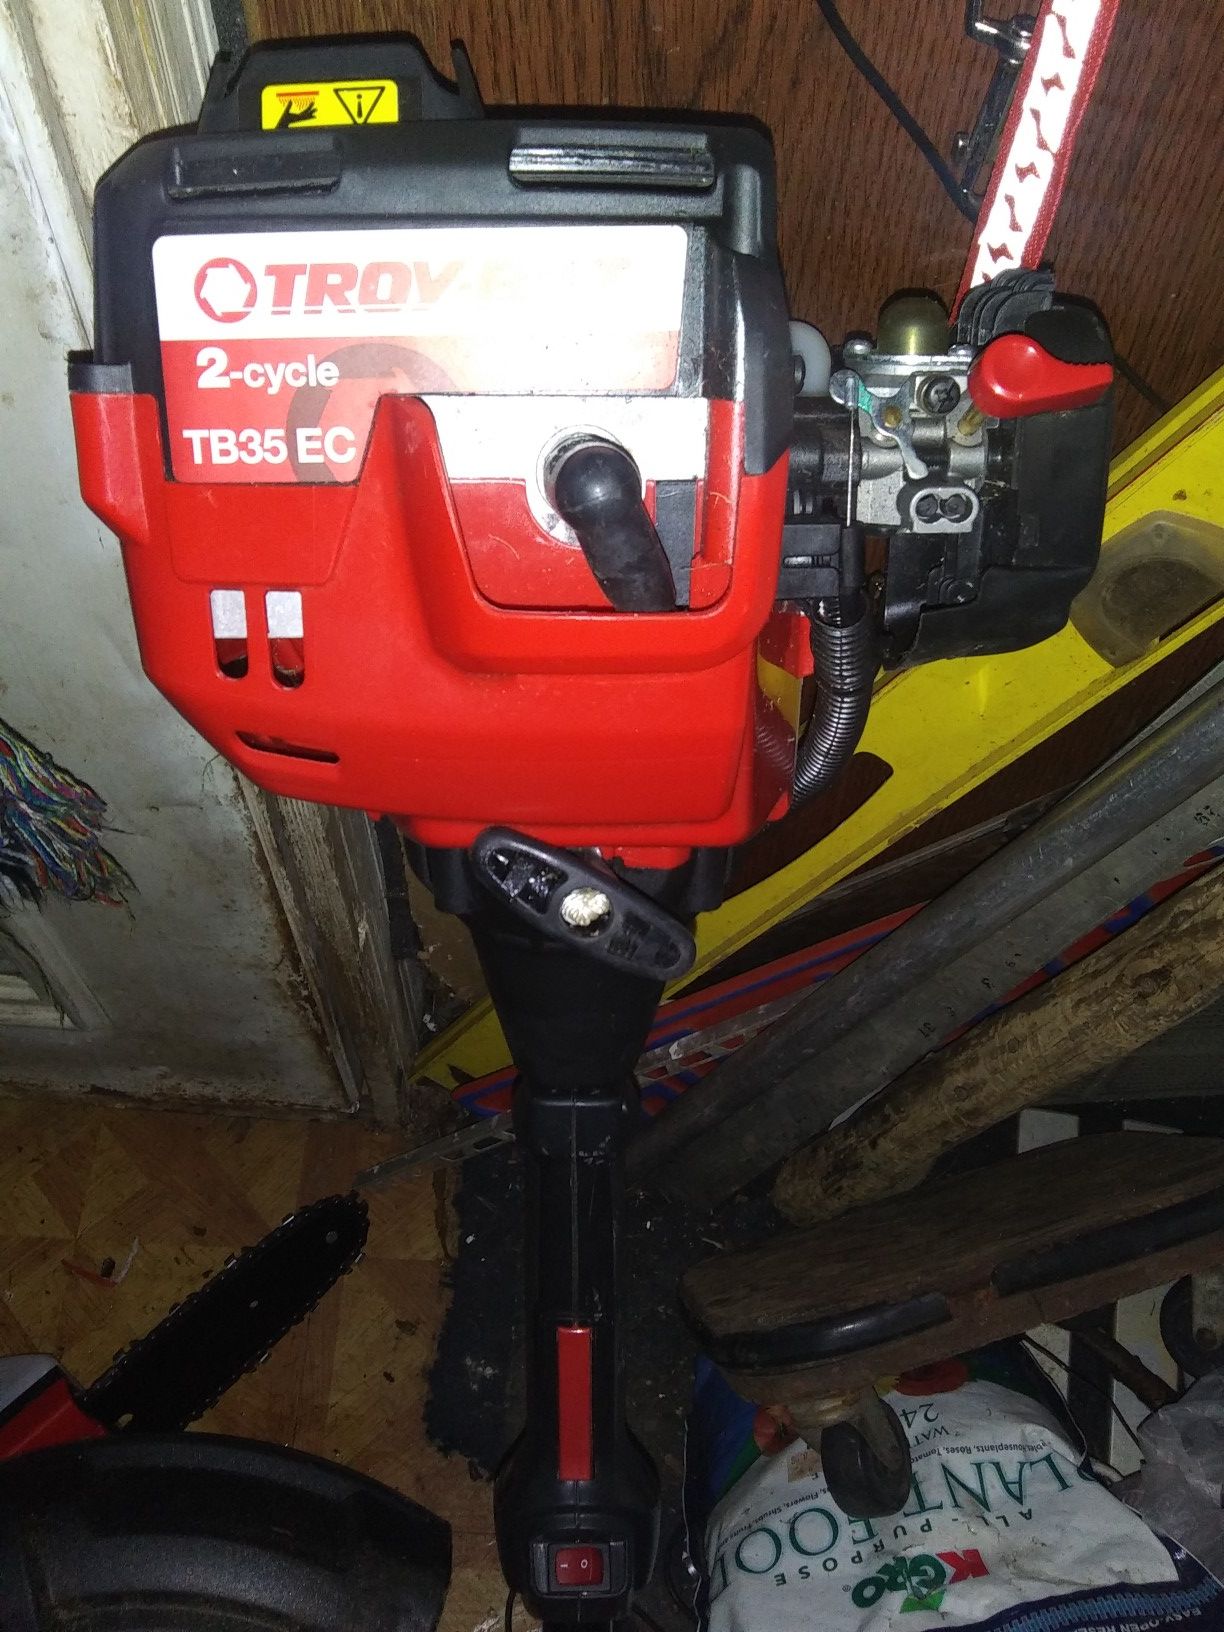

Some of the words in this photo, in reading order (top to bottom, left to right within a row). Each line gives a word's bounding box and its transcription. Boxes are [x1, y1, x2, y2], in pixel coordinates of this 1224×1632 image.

[196, 346, 340, 395] 2-cycle
[182, 428, 289, 465] TB35
[295, 426, 357, 464] EC
[911, 1424, 950, 1448] WAT
[910, 1447, 943, 1464] Tomato
[783, 1493, 819, 1509] Flowers,
